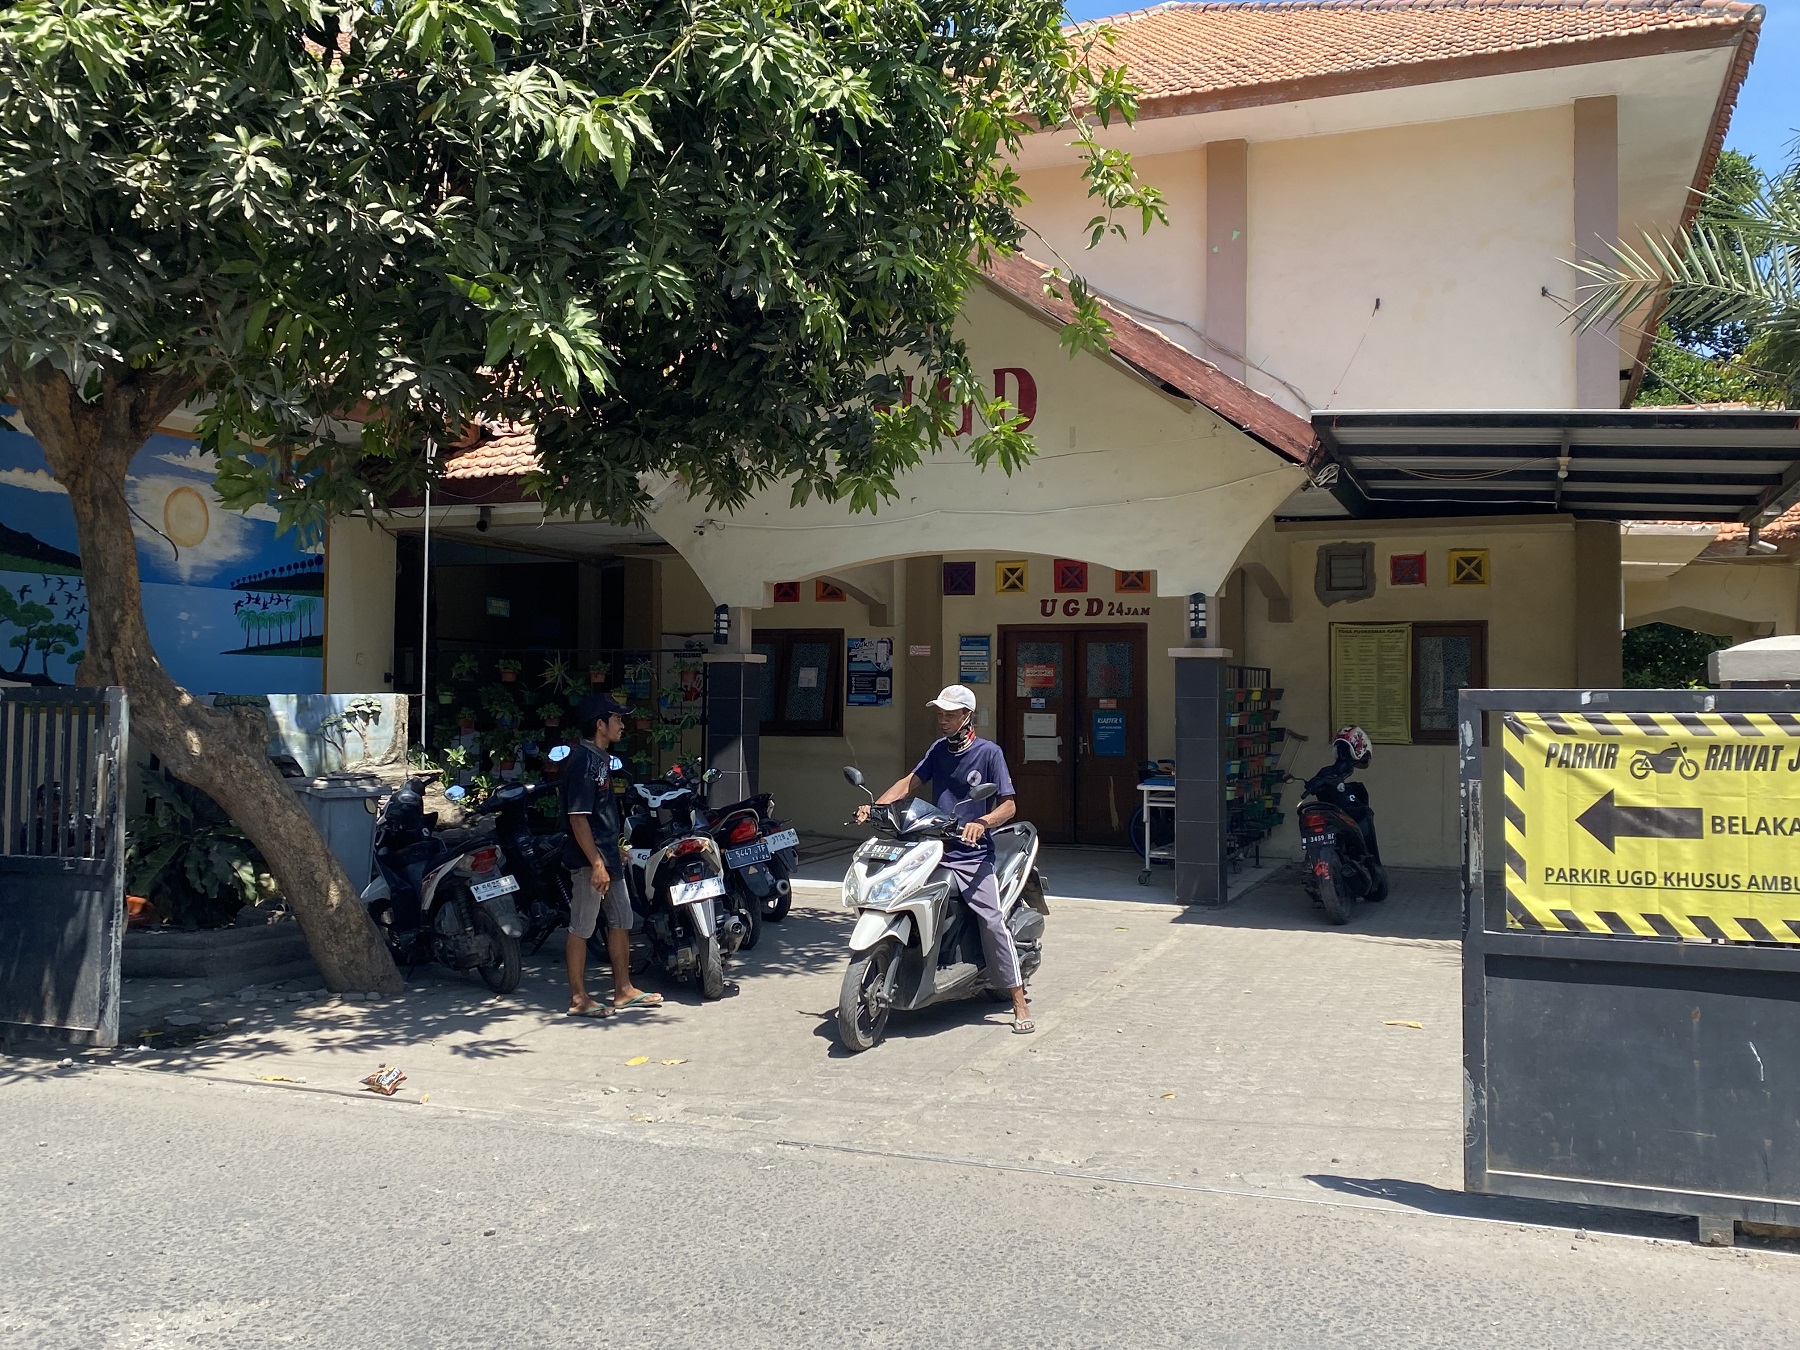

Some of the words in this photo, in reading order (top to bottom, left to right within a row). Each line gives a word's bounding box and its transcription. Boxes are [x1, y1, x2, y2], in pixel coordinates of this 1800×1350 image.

[1040, 598, 1104, 617] UGD
[1107, 601, 1123, 616] 24
[1124, 607, 1150, 616] JAM
[1544, 743, 1620, 770] PARKIR
[1704, 744, 1784, 772] RAWAT
[1711, 815, 1800, 837] BELAKA
[735, 847, 752, 858] 5447
[757, 844, 766, 853] TF
[684, 881, 705, 891] 4354
[1544, 867, 1610, 886] PARKIR
[1616, 870, 1657, 887] UGD
[1663, 872, 1741, 890] KHUSUS
